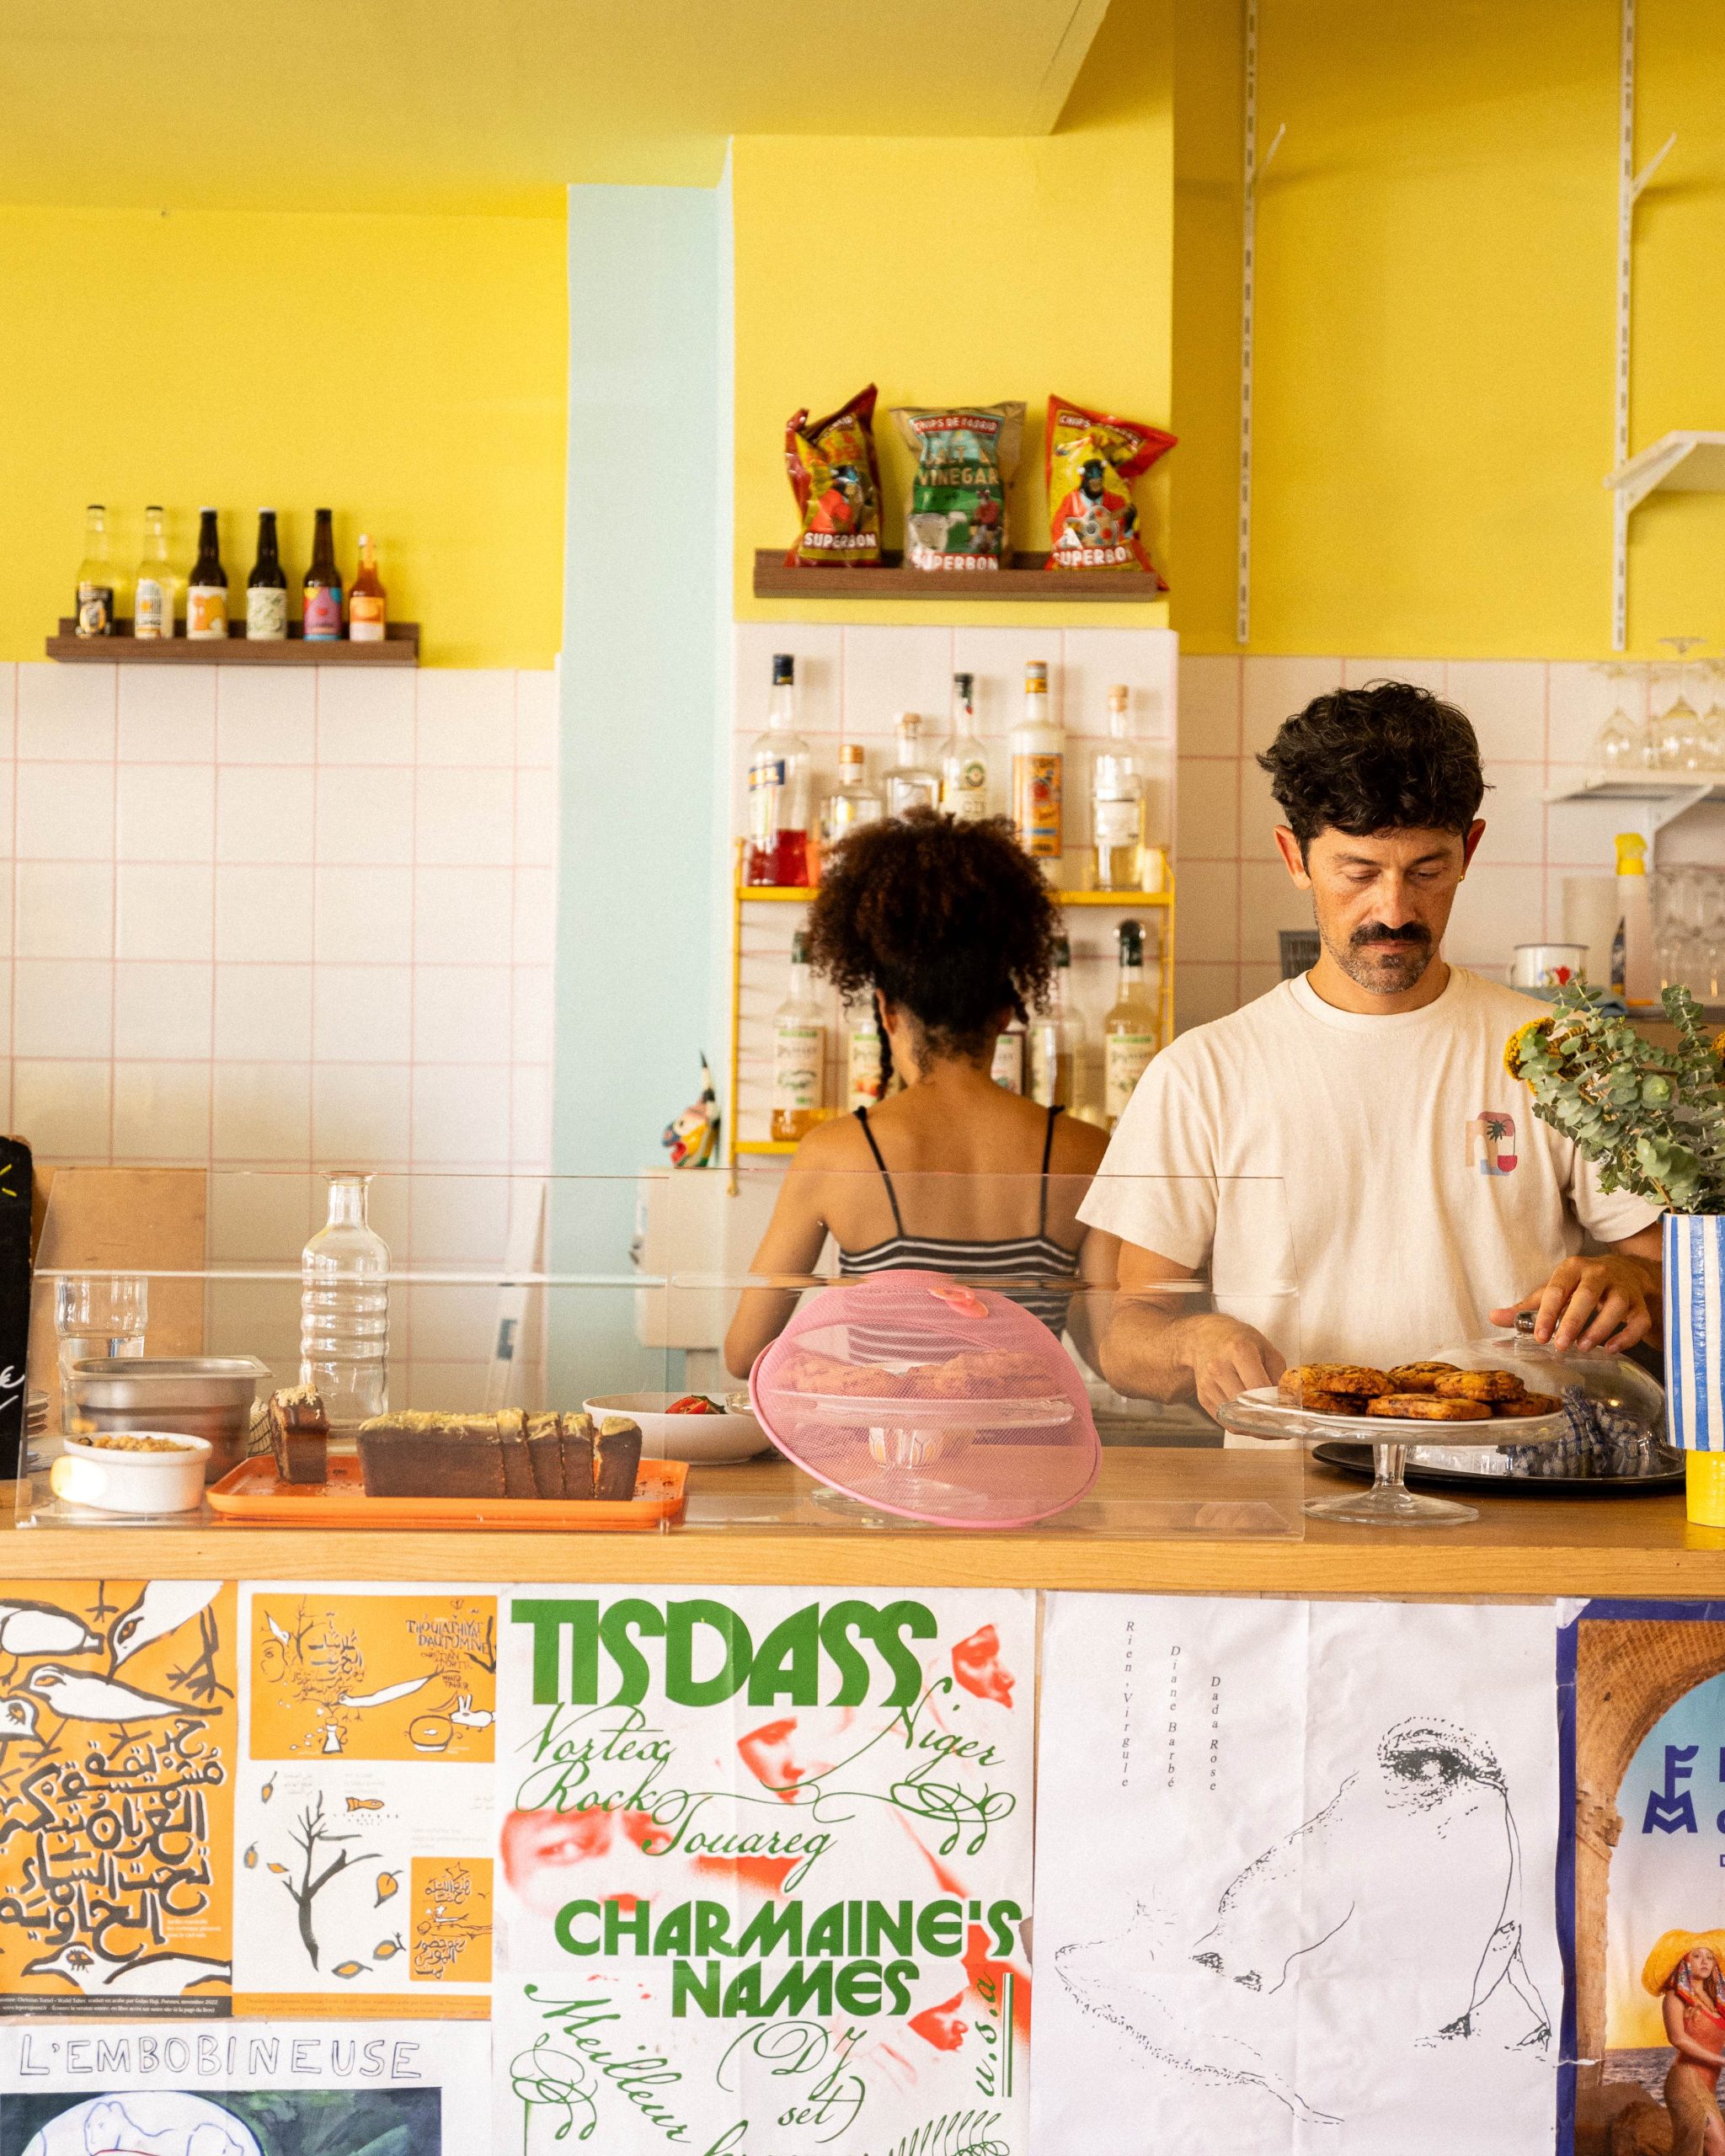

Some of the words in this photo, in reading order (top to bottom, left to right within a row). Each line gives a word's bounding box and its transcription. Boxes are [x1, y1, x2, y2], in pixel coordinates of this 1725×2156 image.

[919, 468, 999, 486] VINEGAR
[803, 531, 877, 549] SUPERBON
[511, 1598, 937, 1706] TISDASS
[1170, 1646, 1181, 1711] Diane
[1210, 1677, 1221, 1728] Dada
[516, 1702, 676, 1764] Vortex
[1167, 1722, 1178, 1788] Barbé
[515, 1754, 671, 1813] Rock
[1210, 1739, 1219, 1790] Rose
[643, 1790, 837, 1892] Touareg
[554, 1899, 1022, 1956] CHARMAINE'S
[672, 1960, 921, 2019] NAMES
[19, 2034, 423, 2079] L'EMBOBINEUSE
[524, 1983, 692, 2143] Meilleur
